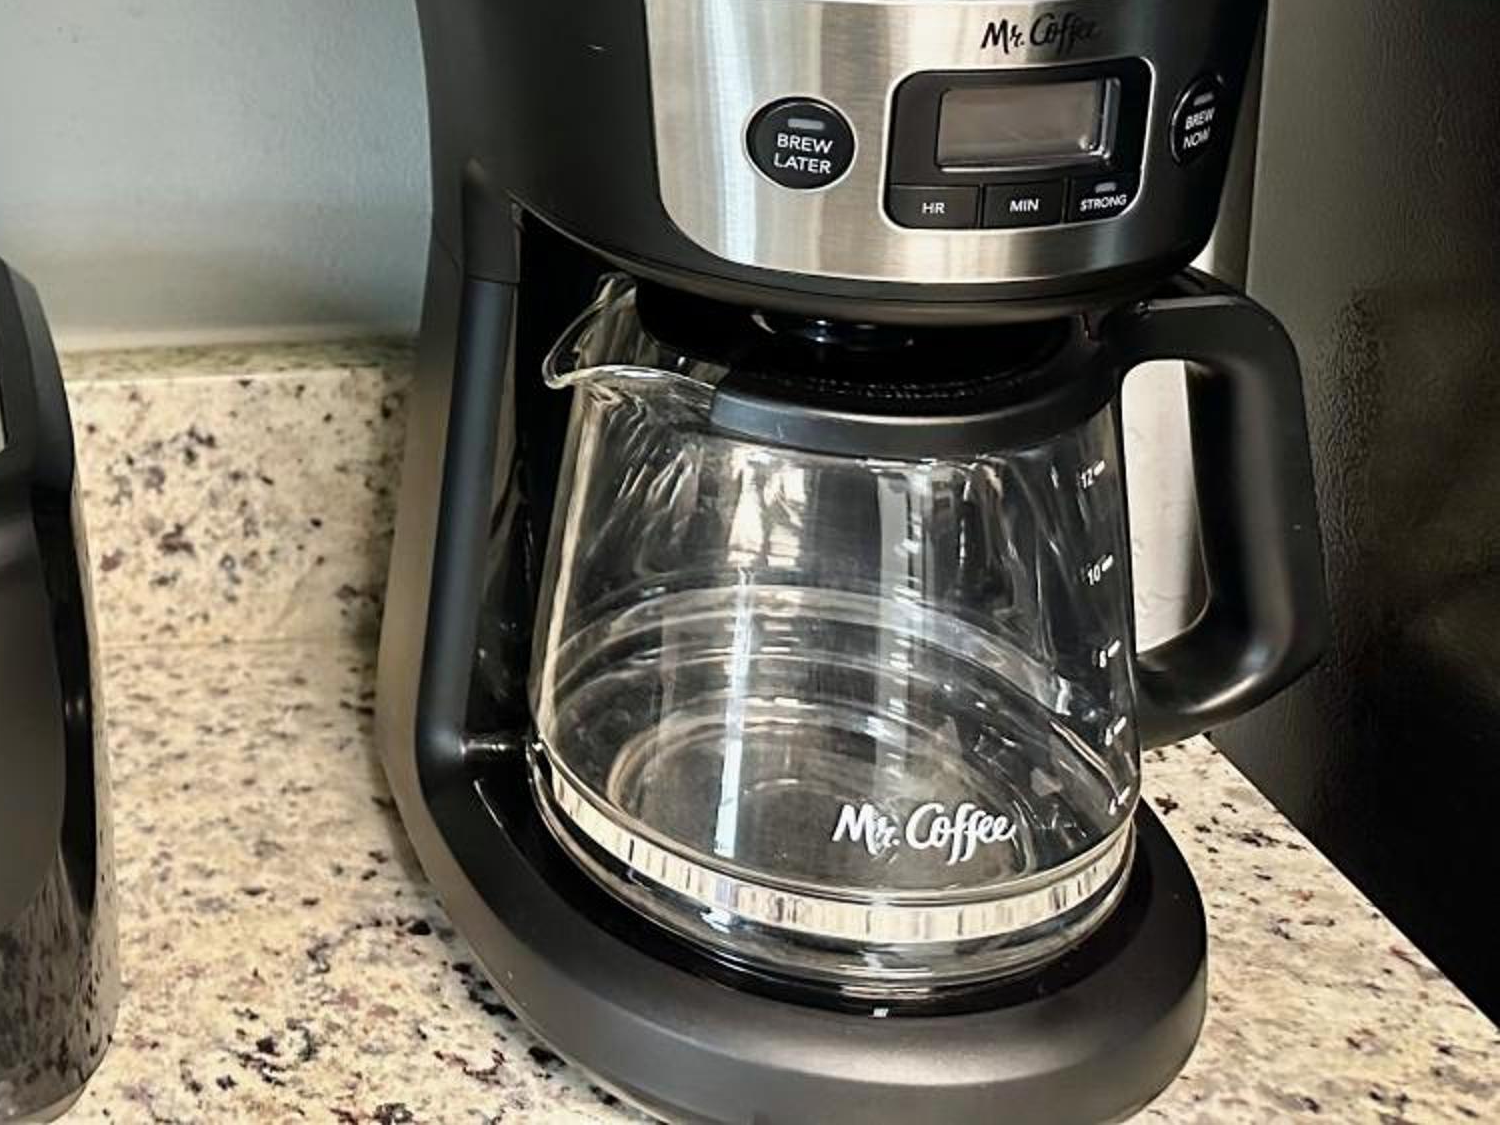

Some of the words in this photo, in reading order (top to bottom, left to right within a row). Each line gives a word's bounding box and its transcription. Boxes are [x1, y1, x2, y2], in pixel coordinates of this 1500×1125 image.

[981, 18, 1025, 54] Mr.
[1029, 12, 1100, 55] Coffee
[1185, 107, 1215, 130] BREW
[777, 133, 834, 153] BREW
[1183, 125, 1211, 149] NOW
[773, 153, 832, 174] LATER
[921, 202, 946, 214] HR
[1009, 198, 1040, 212] MIN
[1079, 194, 1128, 212] STRONG
[1081, 468, 1095, 489] 12
[1087, 564, 1102, 586] 10
[832, 803, 900, 856] Mr.
[905, 802, 1016, 866] Coffee
